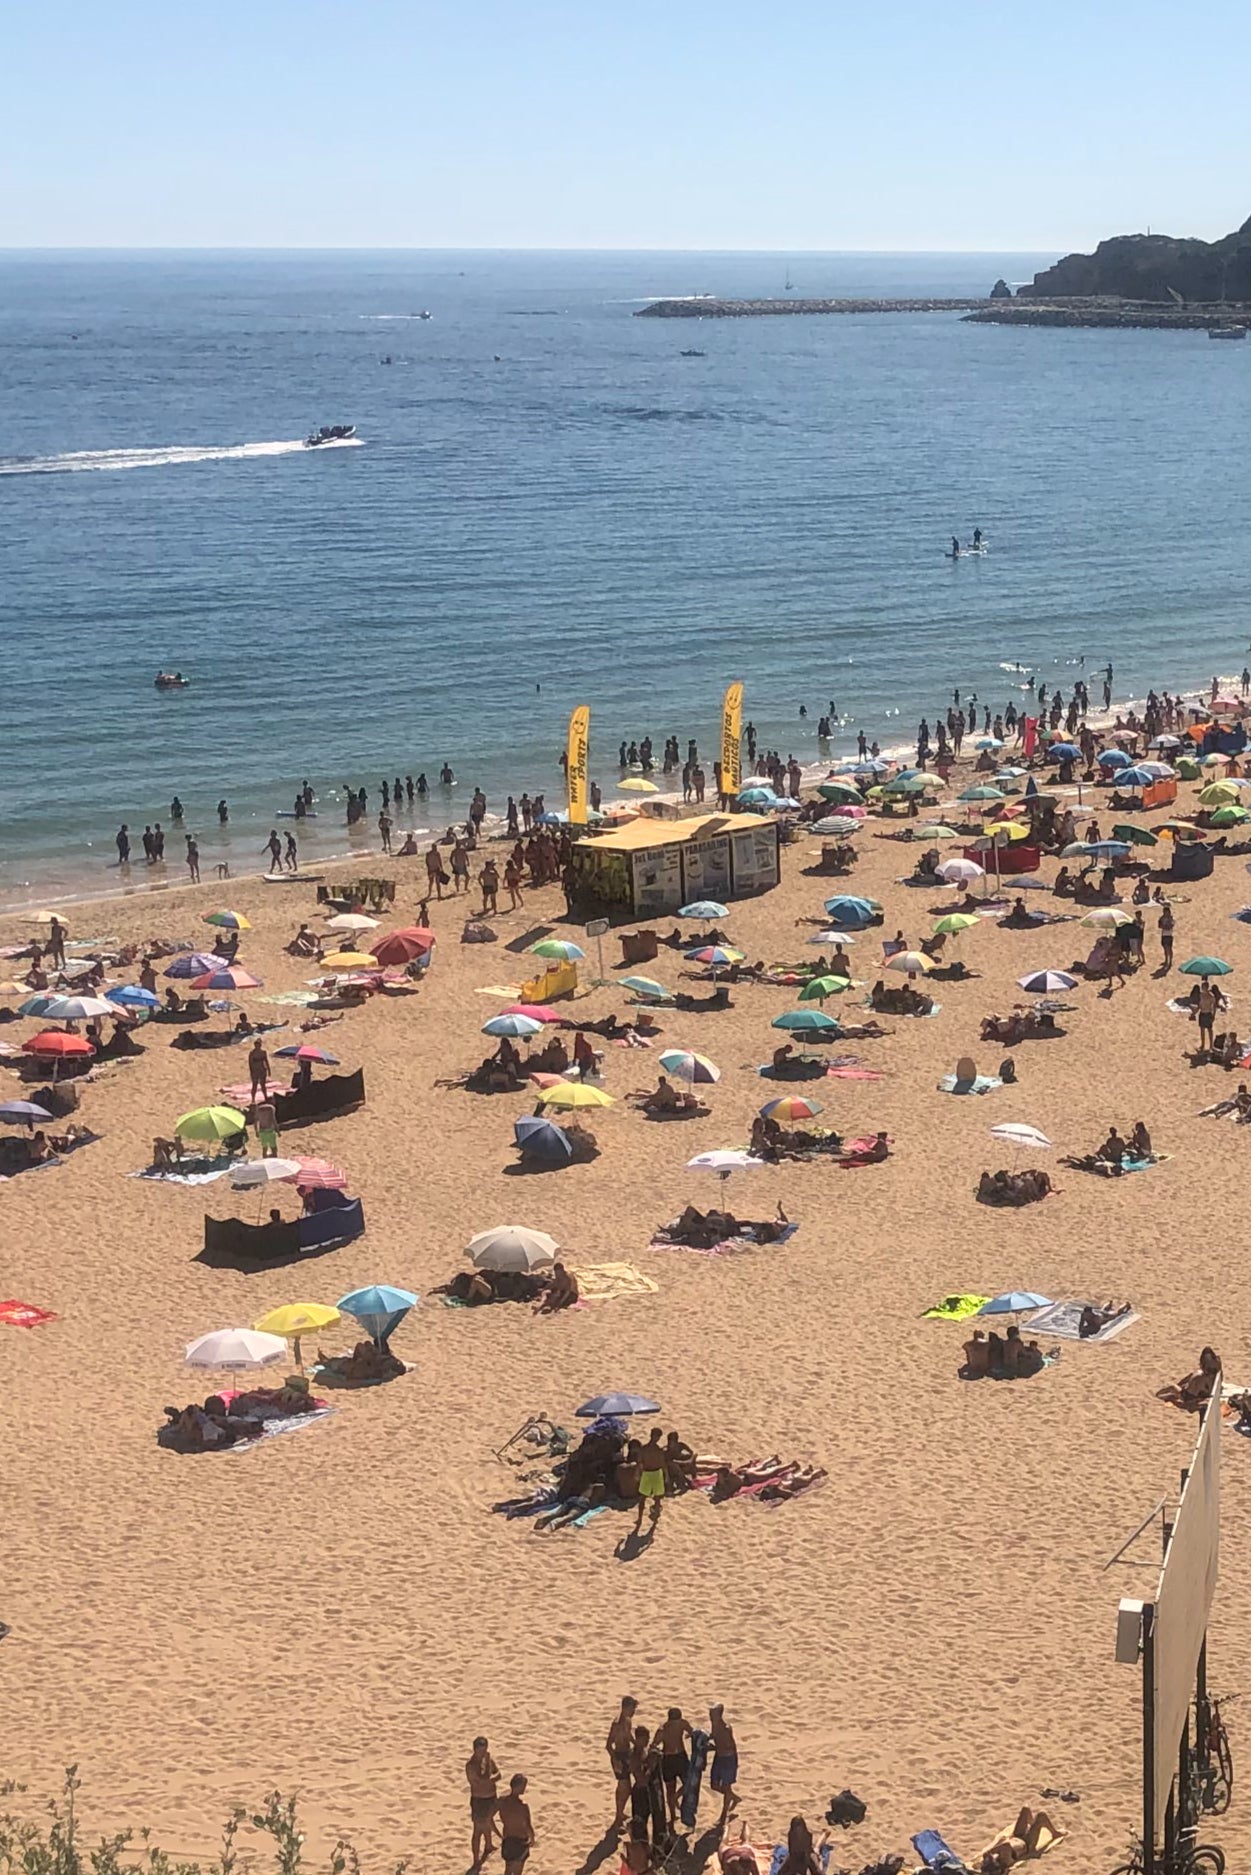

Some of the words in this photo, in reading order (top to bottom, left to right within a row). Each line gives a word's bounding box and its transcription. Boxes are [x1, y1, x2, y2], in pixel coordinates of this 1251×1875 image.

[577, 738, 586, 781] SPORTS
[723, 712, 732, 774] DESPORTOS
[570, 765, 578, 803] WATER
